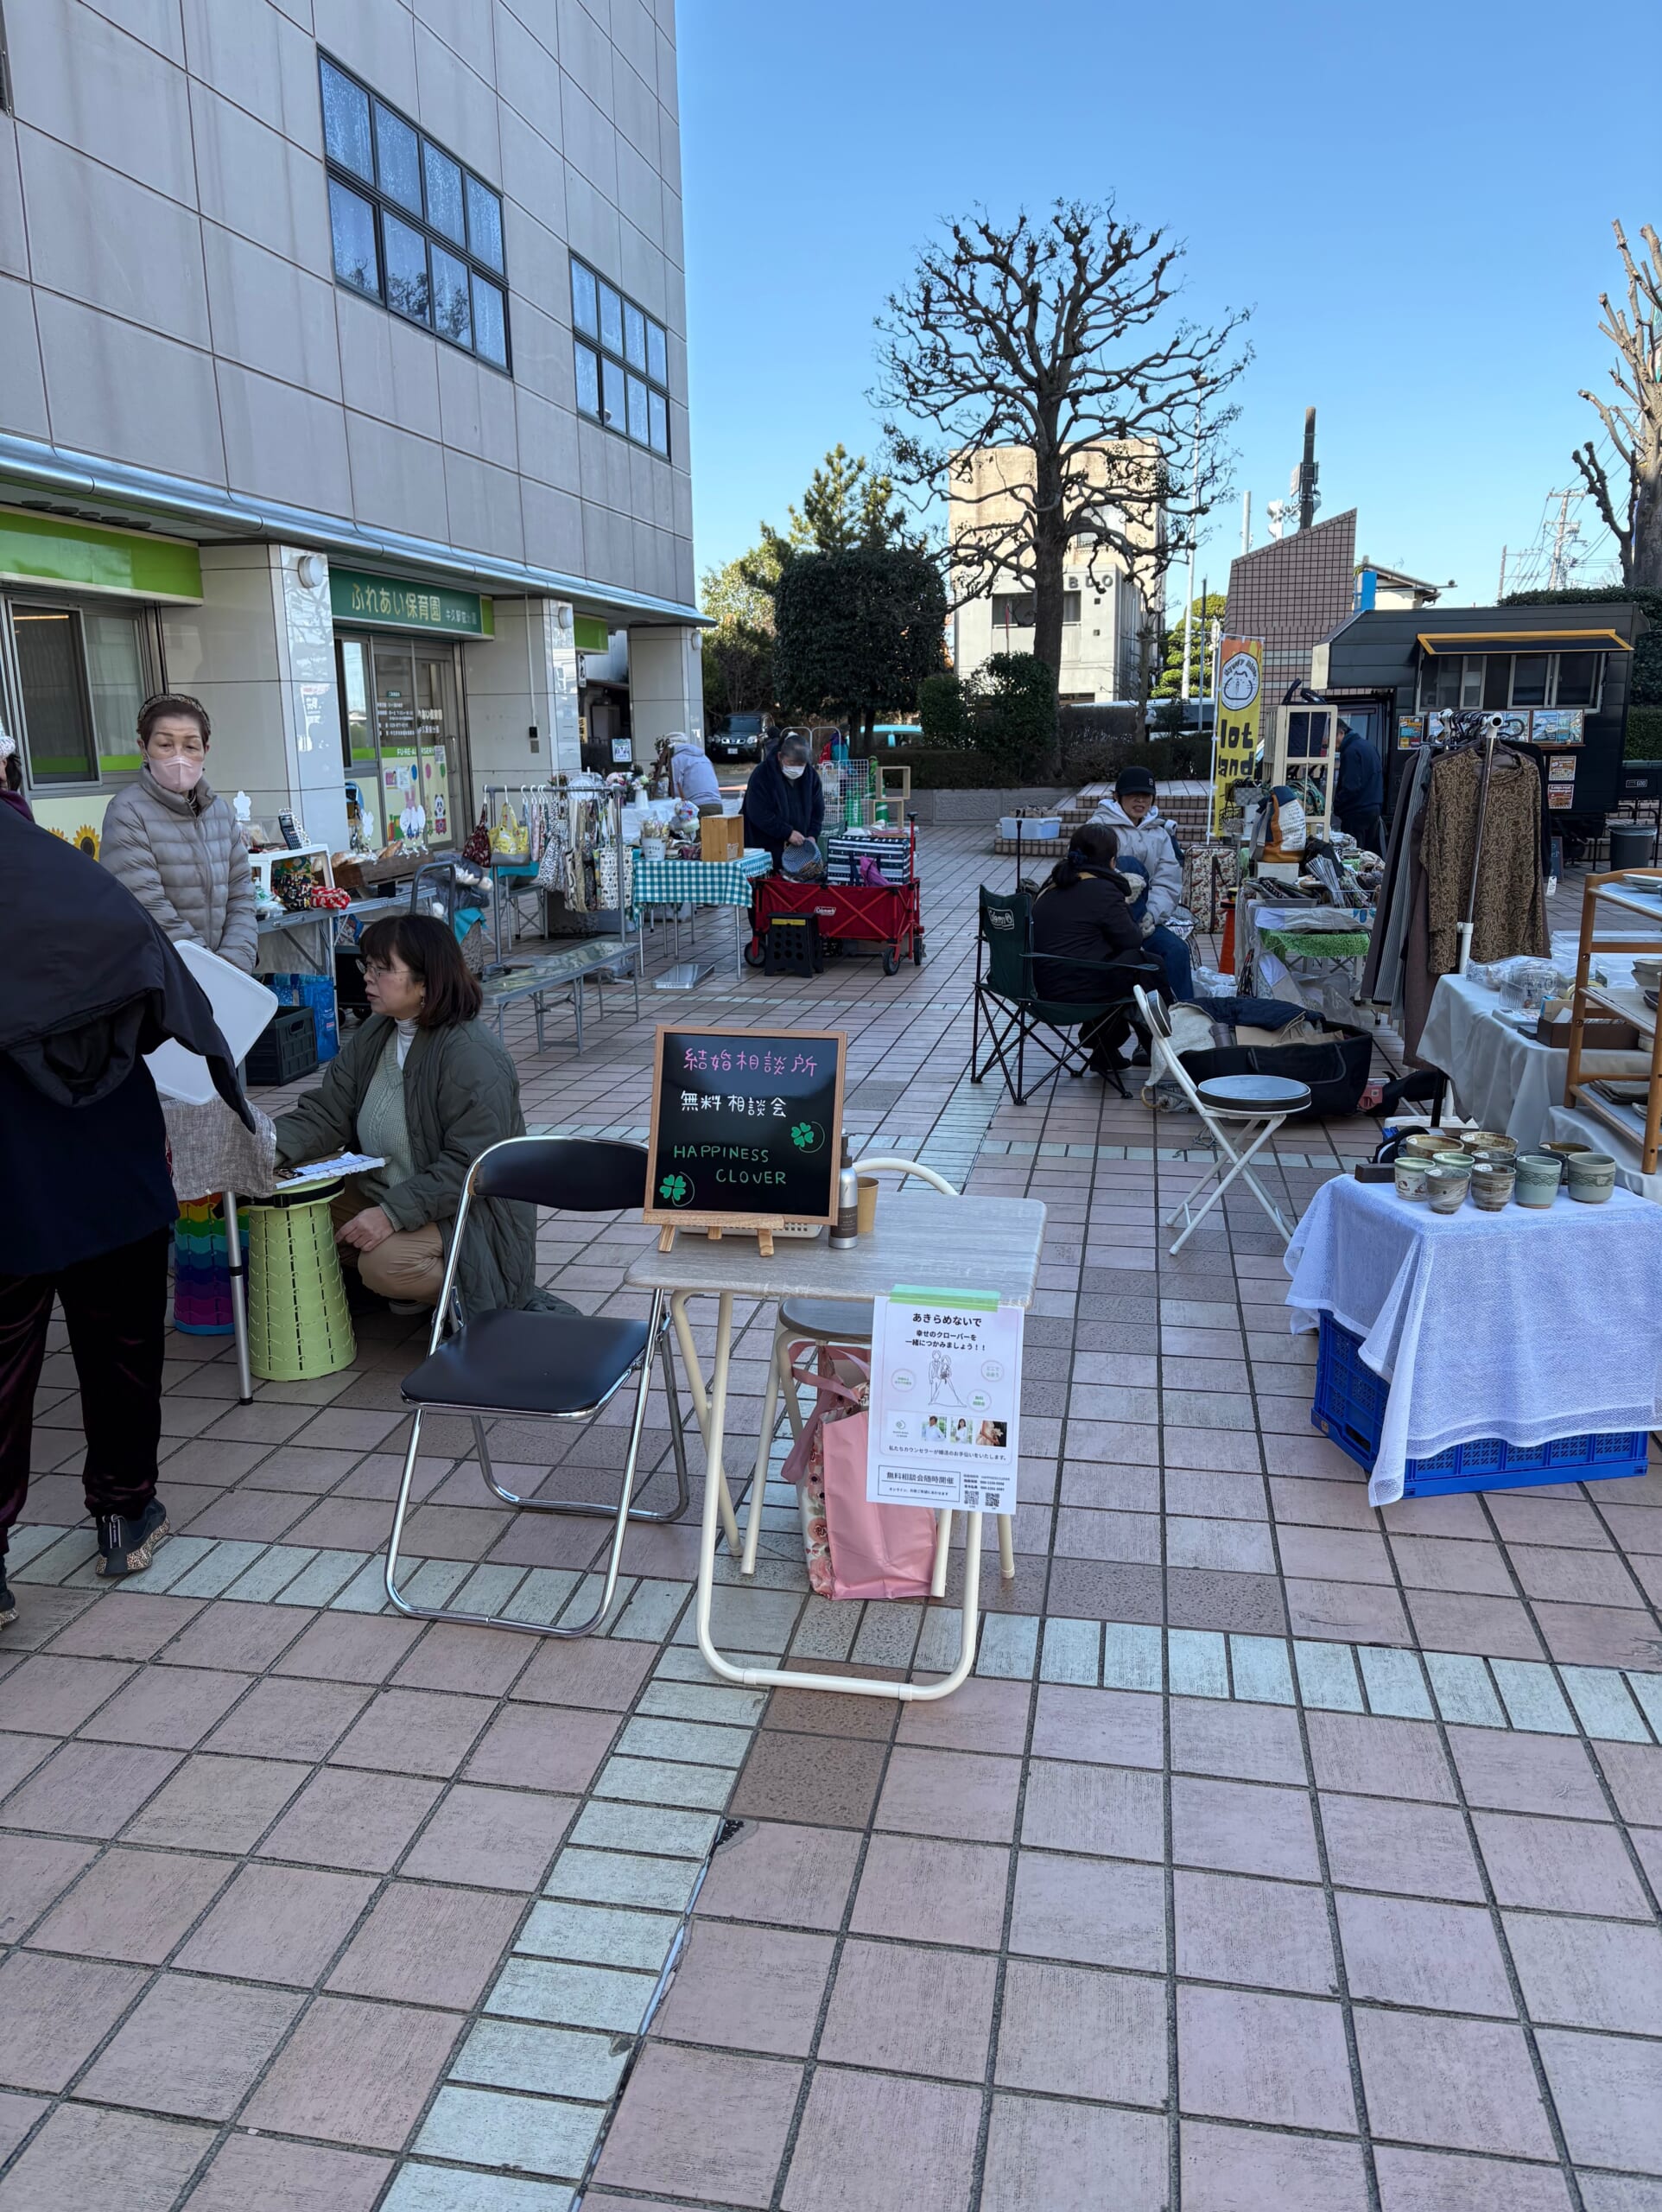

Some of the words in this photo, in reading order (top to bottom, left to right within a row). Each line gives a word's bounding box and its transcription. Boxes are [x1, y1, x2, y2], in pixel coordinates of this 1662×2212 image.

[352, 582, 441, 622] ふれあい保育園
[683, 1047, 818, 1077] 結婚相談所
[680, 1090, 787, 1118] 無料相談会
[673, 1145, 770, 1164] HAPPINESS
[715, 1168, 787, 1185] CLOVER
[912, 1313, 982, 1327] あきらめないで
[916, 1329, 977, 1342] 幸せのクローバーを
[905, 1338, 986, 1351] 一緒につかみましょう！！
[886, 1471, 955, 1484] 無料相談会随時開催
